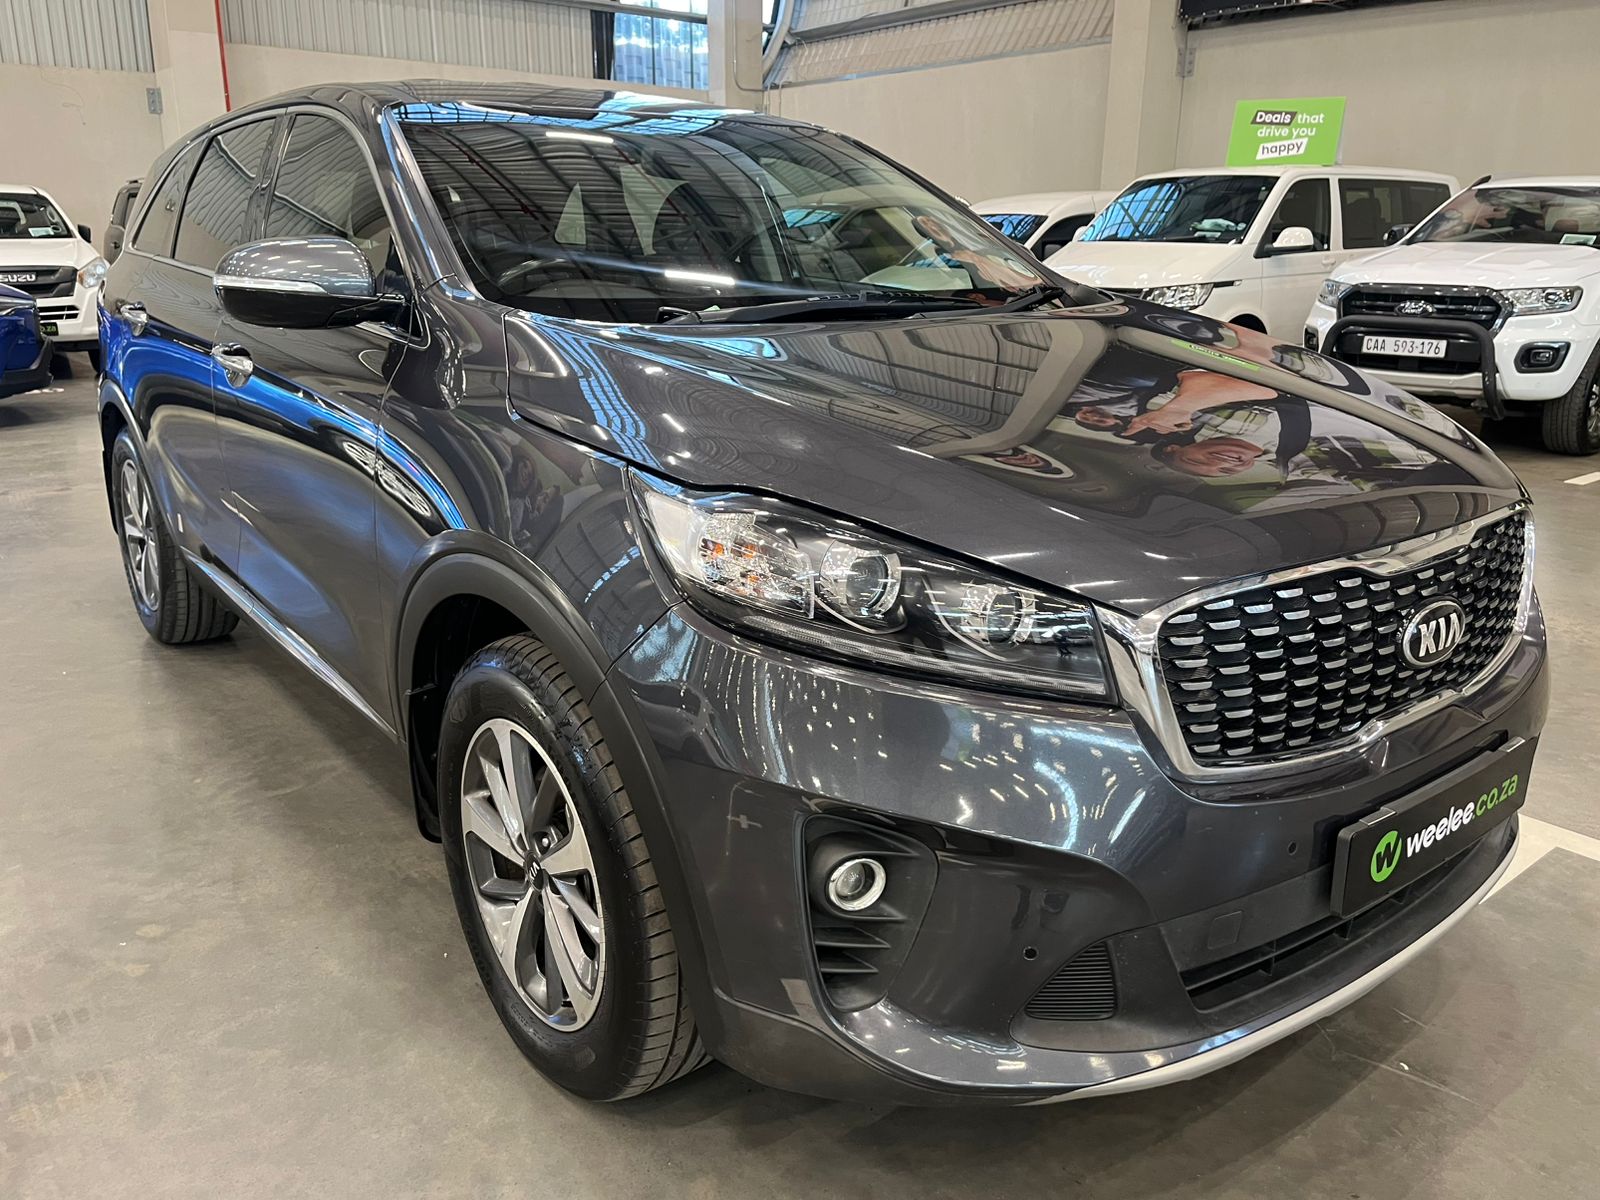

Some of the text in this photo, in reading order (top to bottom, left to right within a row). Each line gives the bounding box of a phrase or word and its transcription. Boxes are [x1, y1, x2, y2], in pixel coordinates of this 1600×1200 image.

[1255, 111, 1325, 123] Deals that
[1257, 126, 1316, 139] drive you
[1261, 141, 1303, 155] happy
[1366, 338, 1386, 351] CAA
[1418, 612, 1461, 657] KIA
[1406, 774, 1518, 858] weelee.co.za
